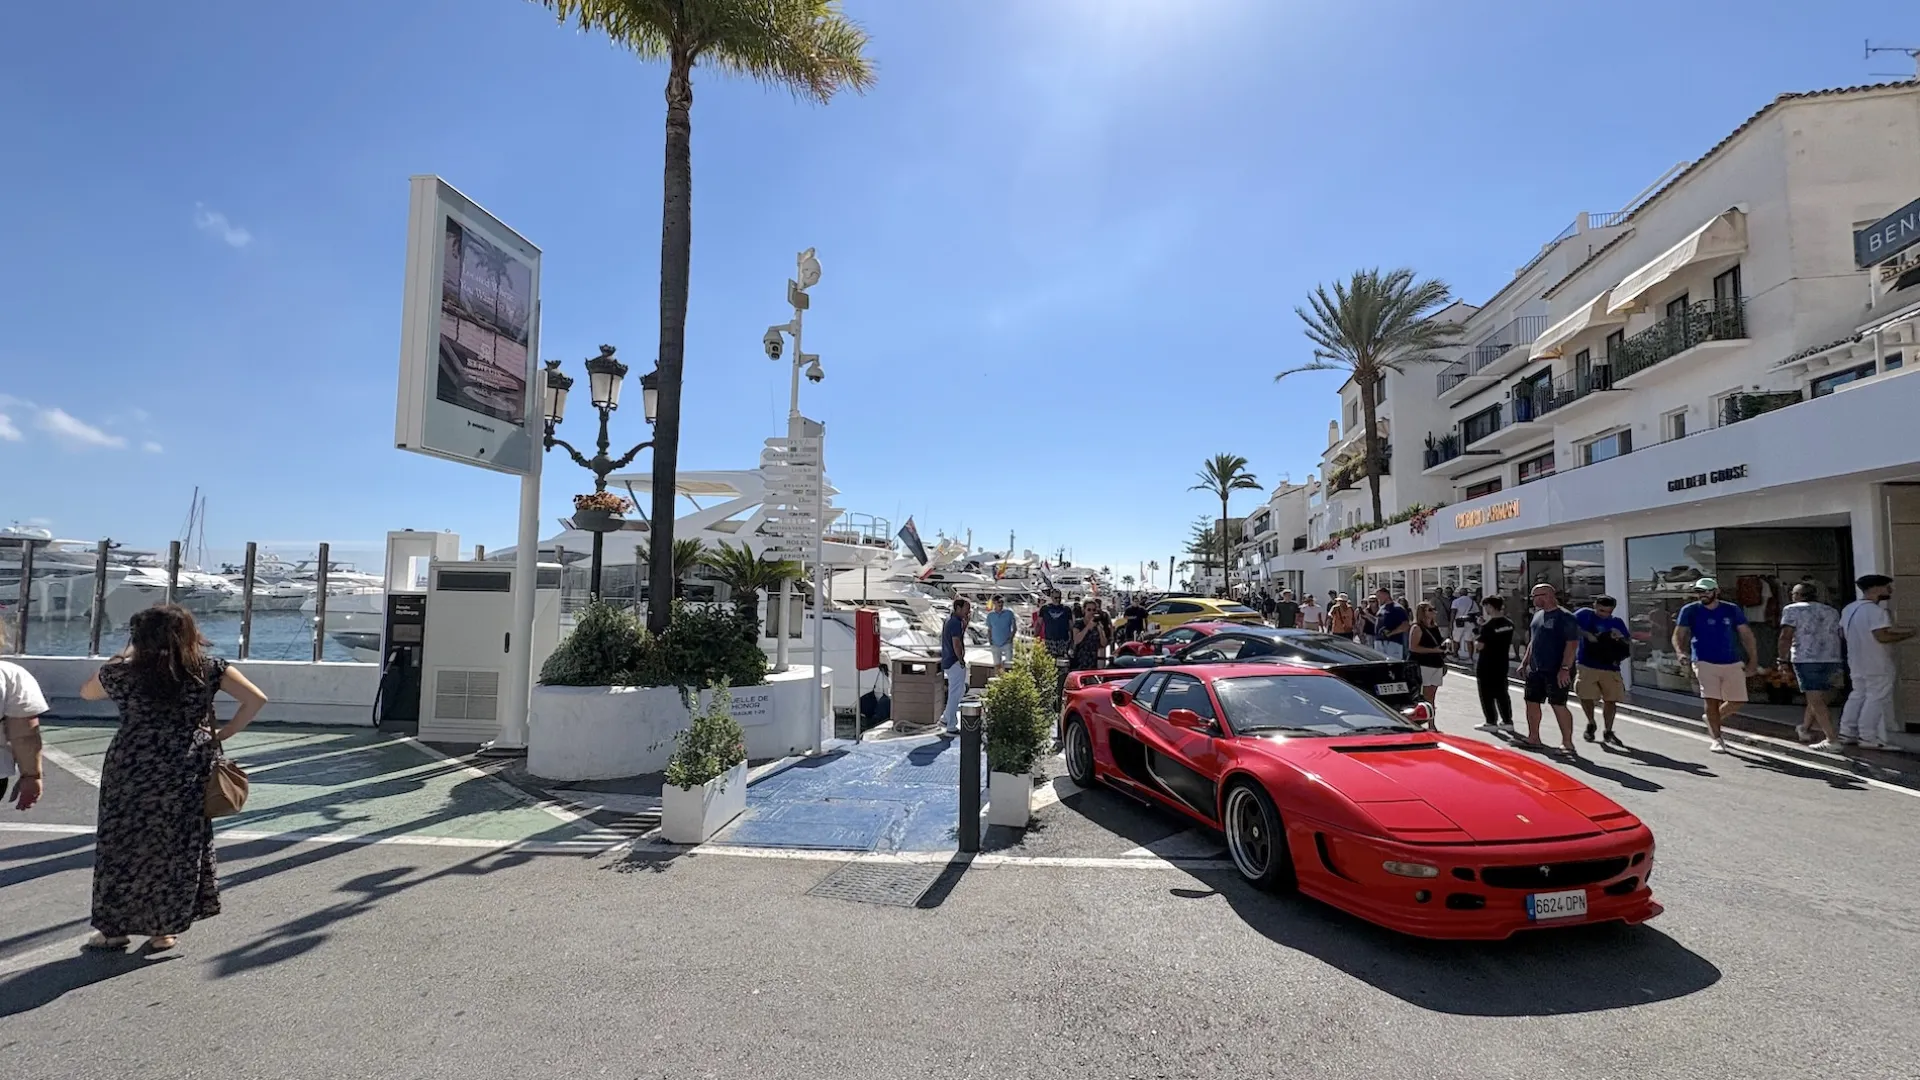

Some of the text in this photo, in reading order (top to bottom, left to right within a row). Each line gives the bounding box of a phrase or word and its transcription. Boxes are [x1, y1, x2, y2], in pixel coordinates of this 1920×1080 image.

[1869, 209, 1920, 252] BEN
[1667, 464, 1748, 492] GOLDEN GOOSE
[1455, 498, 1520, 530] GIORGIO ARMANI
[1536, 898, 1563, 914] 6624
[1565, 895, 1586, 911] DPN
